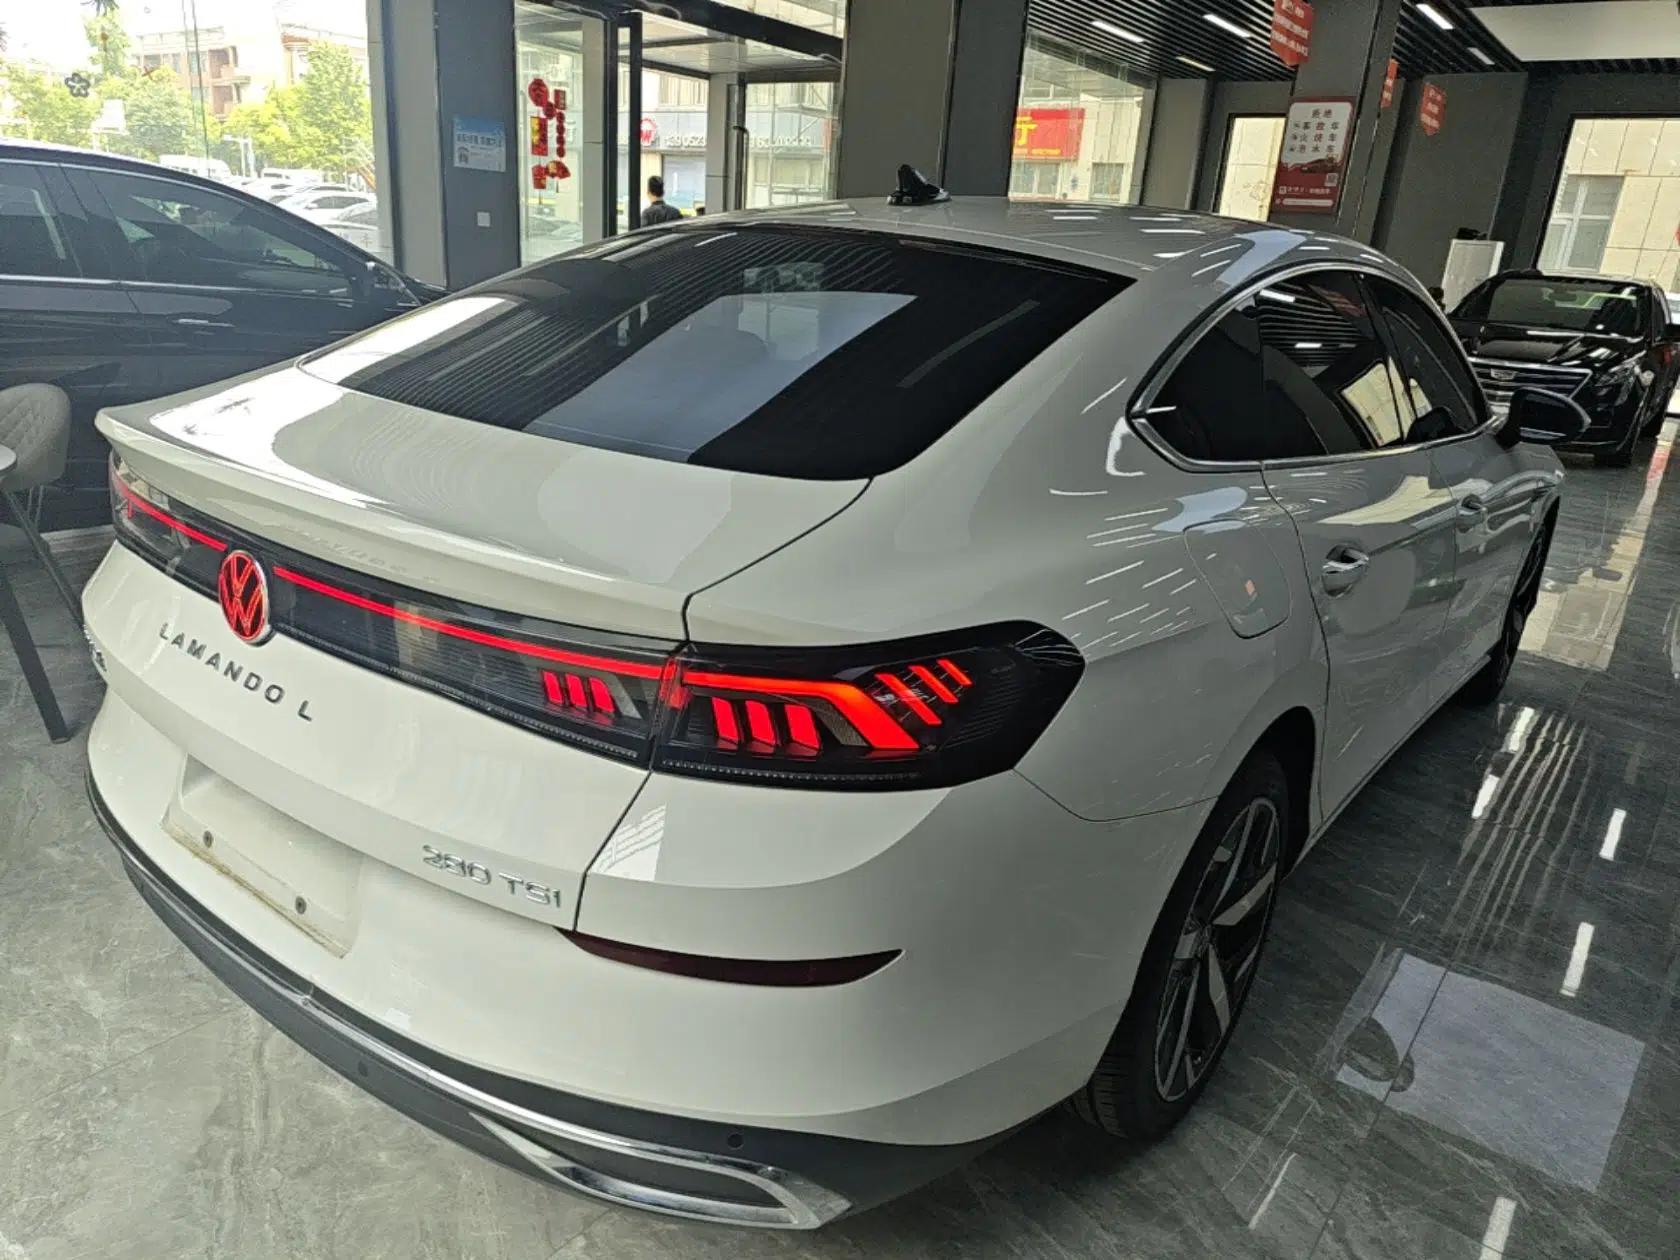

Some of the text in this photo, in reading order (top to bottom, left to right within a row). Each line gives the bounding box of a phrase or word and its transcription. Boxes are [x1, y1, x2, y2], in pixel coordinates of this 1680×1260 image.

[159, 623, 285, 704] LAMANDO
[298, 700, 313, 721] L
[422, 844, 561, 908] 280 TSI
